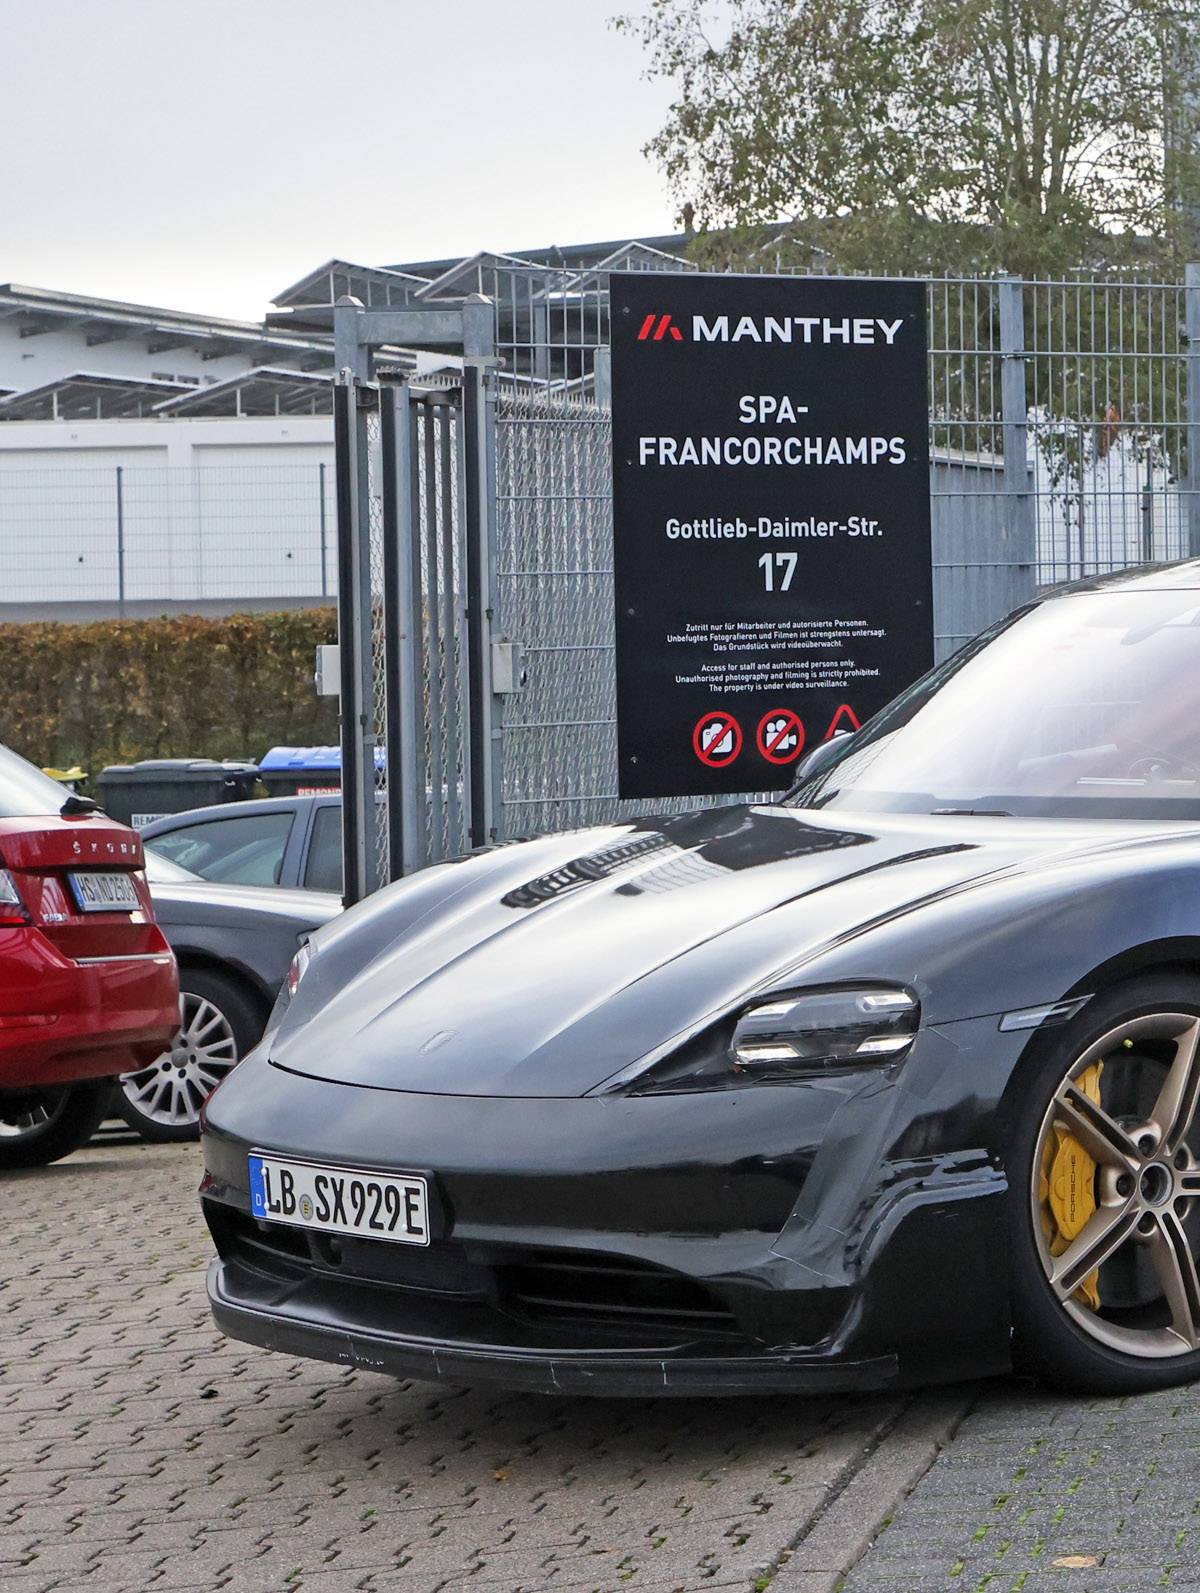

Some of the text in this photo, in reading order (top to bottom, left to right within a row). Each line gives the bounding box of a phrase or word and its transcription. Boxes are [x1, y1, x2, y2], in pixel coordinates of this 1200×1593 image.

[692, 315, 904, 345] MANTHEY
[738, 395, 809, 424] SPA-
[638, 436, 907, 466] FRANCORCHAMPS
[665, 516, 883, 539] Gottlieb-Daimler-Str.
[757, 551, 799, 592] 17
[685, 623, 709, 632] Zutritt
[724, 622, 735, 631] für
[736, 622, 776, 630] Mitarbeiter
[777, 621, 791, 629] und
[792, 621, 833, 629] autorisierte
[834, 619, 869, 627] Personen.
[666, 629, 887, 643] Unbefugtes Fotografieren und Filmen ist strengstens untersagt.
[713, 640, 843, 651] Das Grundstück wird videoüberwacht.
[701, 659, 856, 672] Access for staff and authorised persons only.
[675, 674, 724, 683] Unauthorised
[725, 672, 769, 683] photography
[770, 671, 783, 679] and
[784, 671, 810, 680] filming
[818, 670, 843, 678] strictly
[844, 668, 880, 678] prohibited.
[709, 684, 722, 692] The
[724, 683, 754, 693] property
[763, 682, 784, 690] under
[785, 681, 804, 689] video
[805, 679, 850, 689] surveillance.
[264, 1166, 296, 1215] LB
[256, 1193, 262, 1206] D
